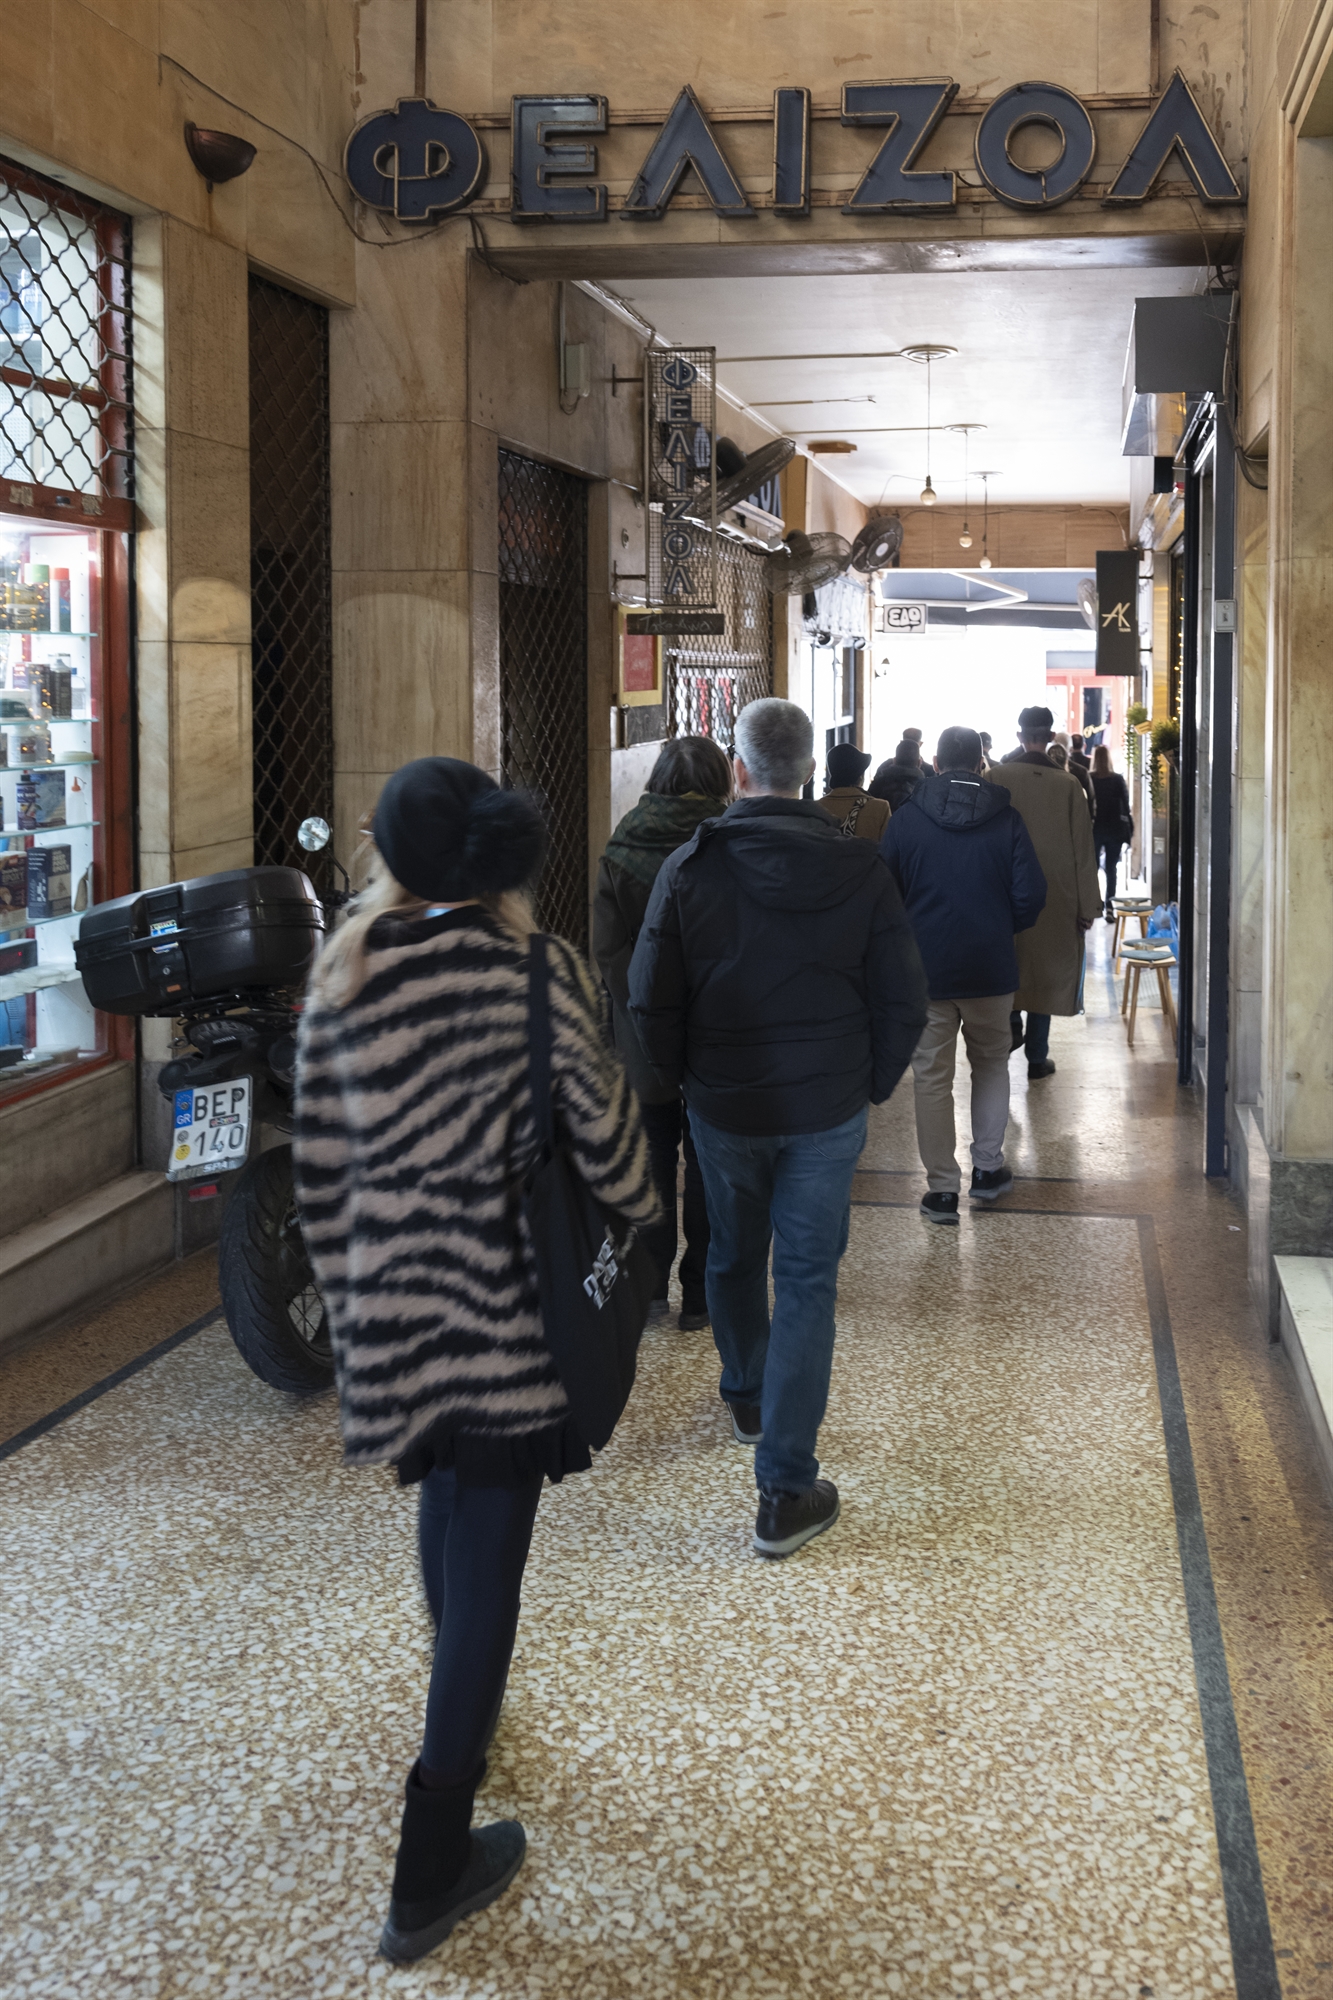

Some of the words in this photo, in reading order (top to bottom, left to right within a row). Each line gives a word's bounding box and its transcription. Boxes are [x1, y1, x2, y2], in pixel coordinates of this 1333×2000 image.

[343, 67, 1244, 223] ΦΕΛΙΖΟΛ
[661, 358, 697, 594] ΦΕΛΙΖΟΛ
[1102, 602, 1131, 627] AK
[177, 1113, 191, 1125] GR
[194, 1087, 245, 1122] BEP
[194, 1124, 245, 1157] 140
